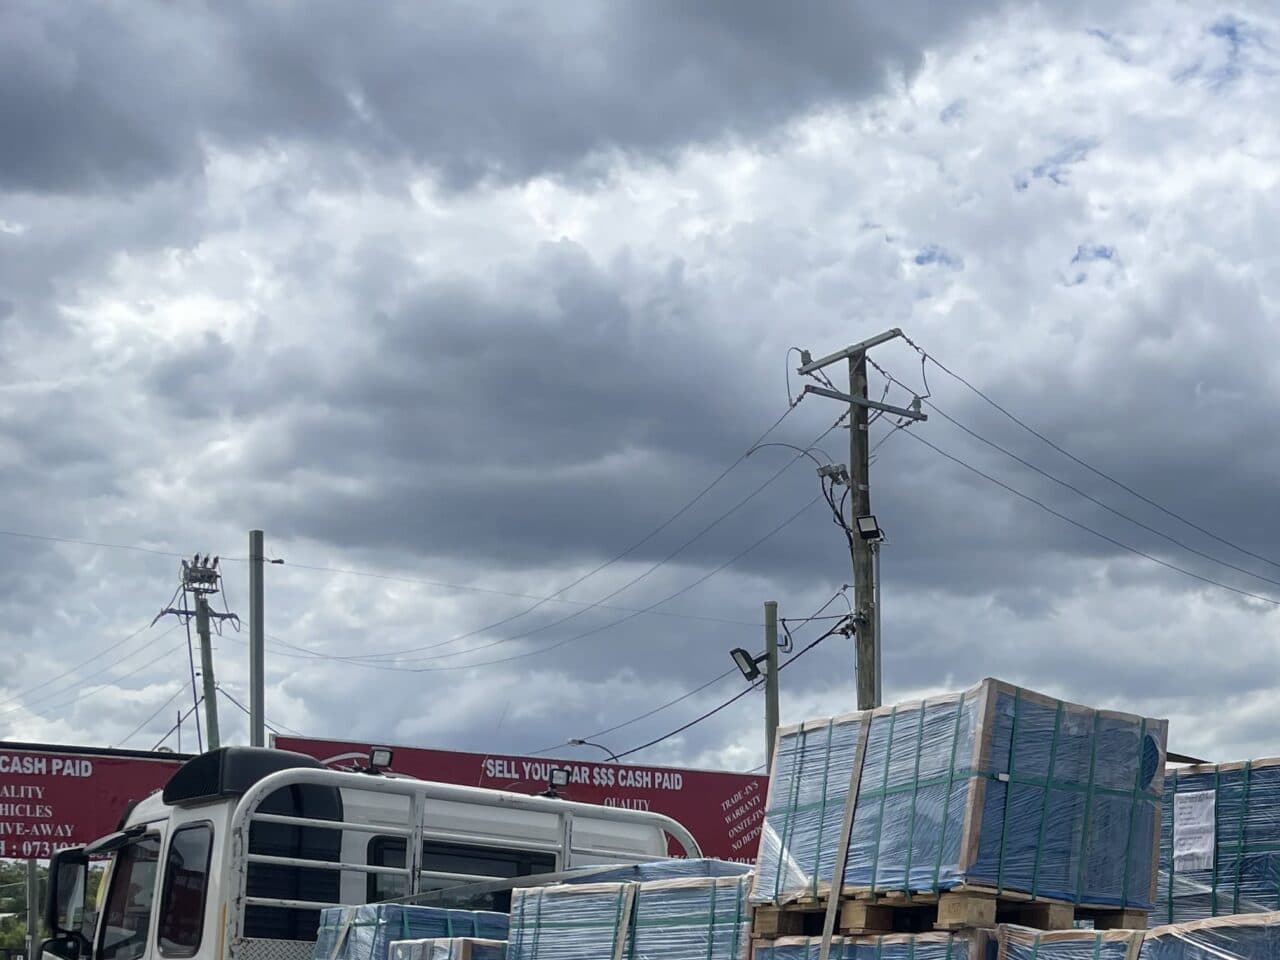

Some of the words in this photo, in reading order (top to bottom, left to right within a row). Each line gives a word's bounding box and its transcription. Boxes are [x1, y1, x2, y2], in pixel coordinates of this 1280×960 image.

[0, 755, 47, 775] CASH
[52, 758, 93, 777] PAID
[486, 759, 519, 779] SELL
[593, 767, 615, 787] $$$
[618, 769, 651, 788] CASH
[655, 771, 683, 790] PAID
